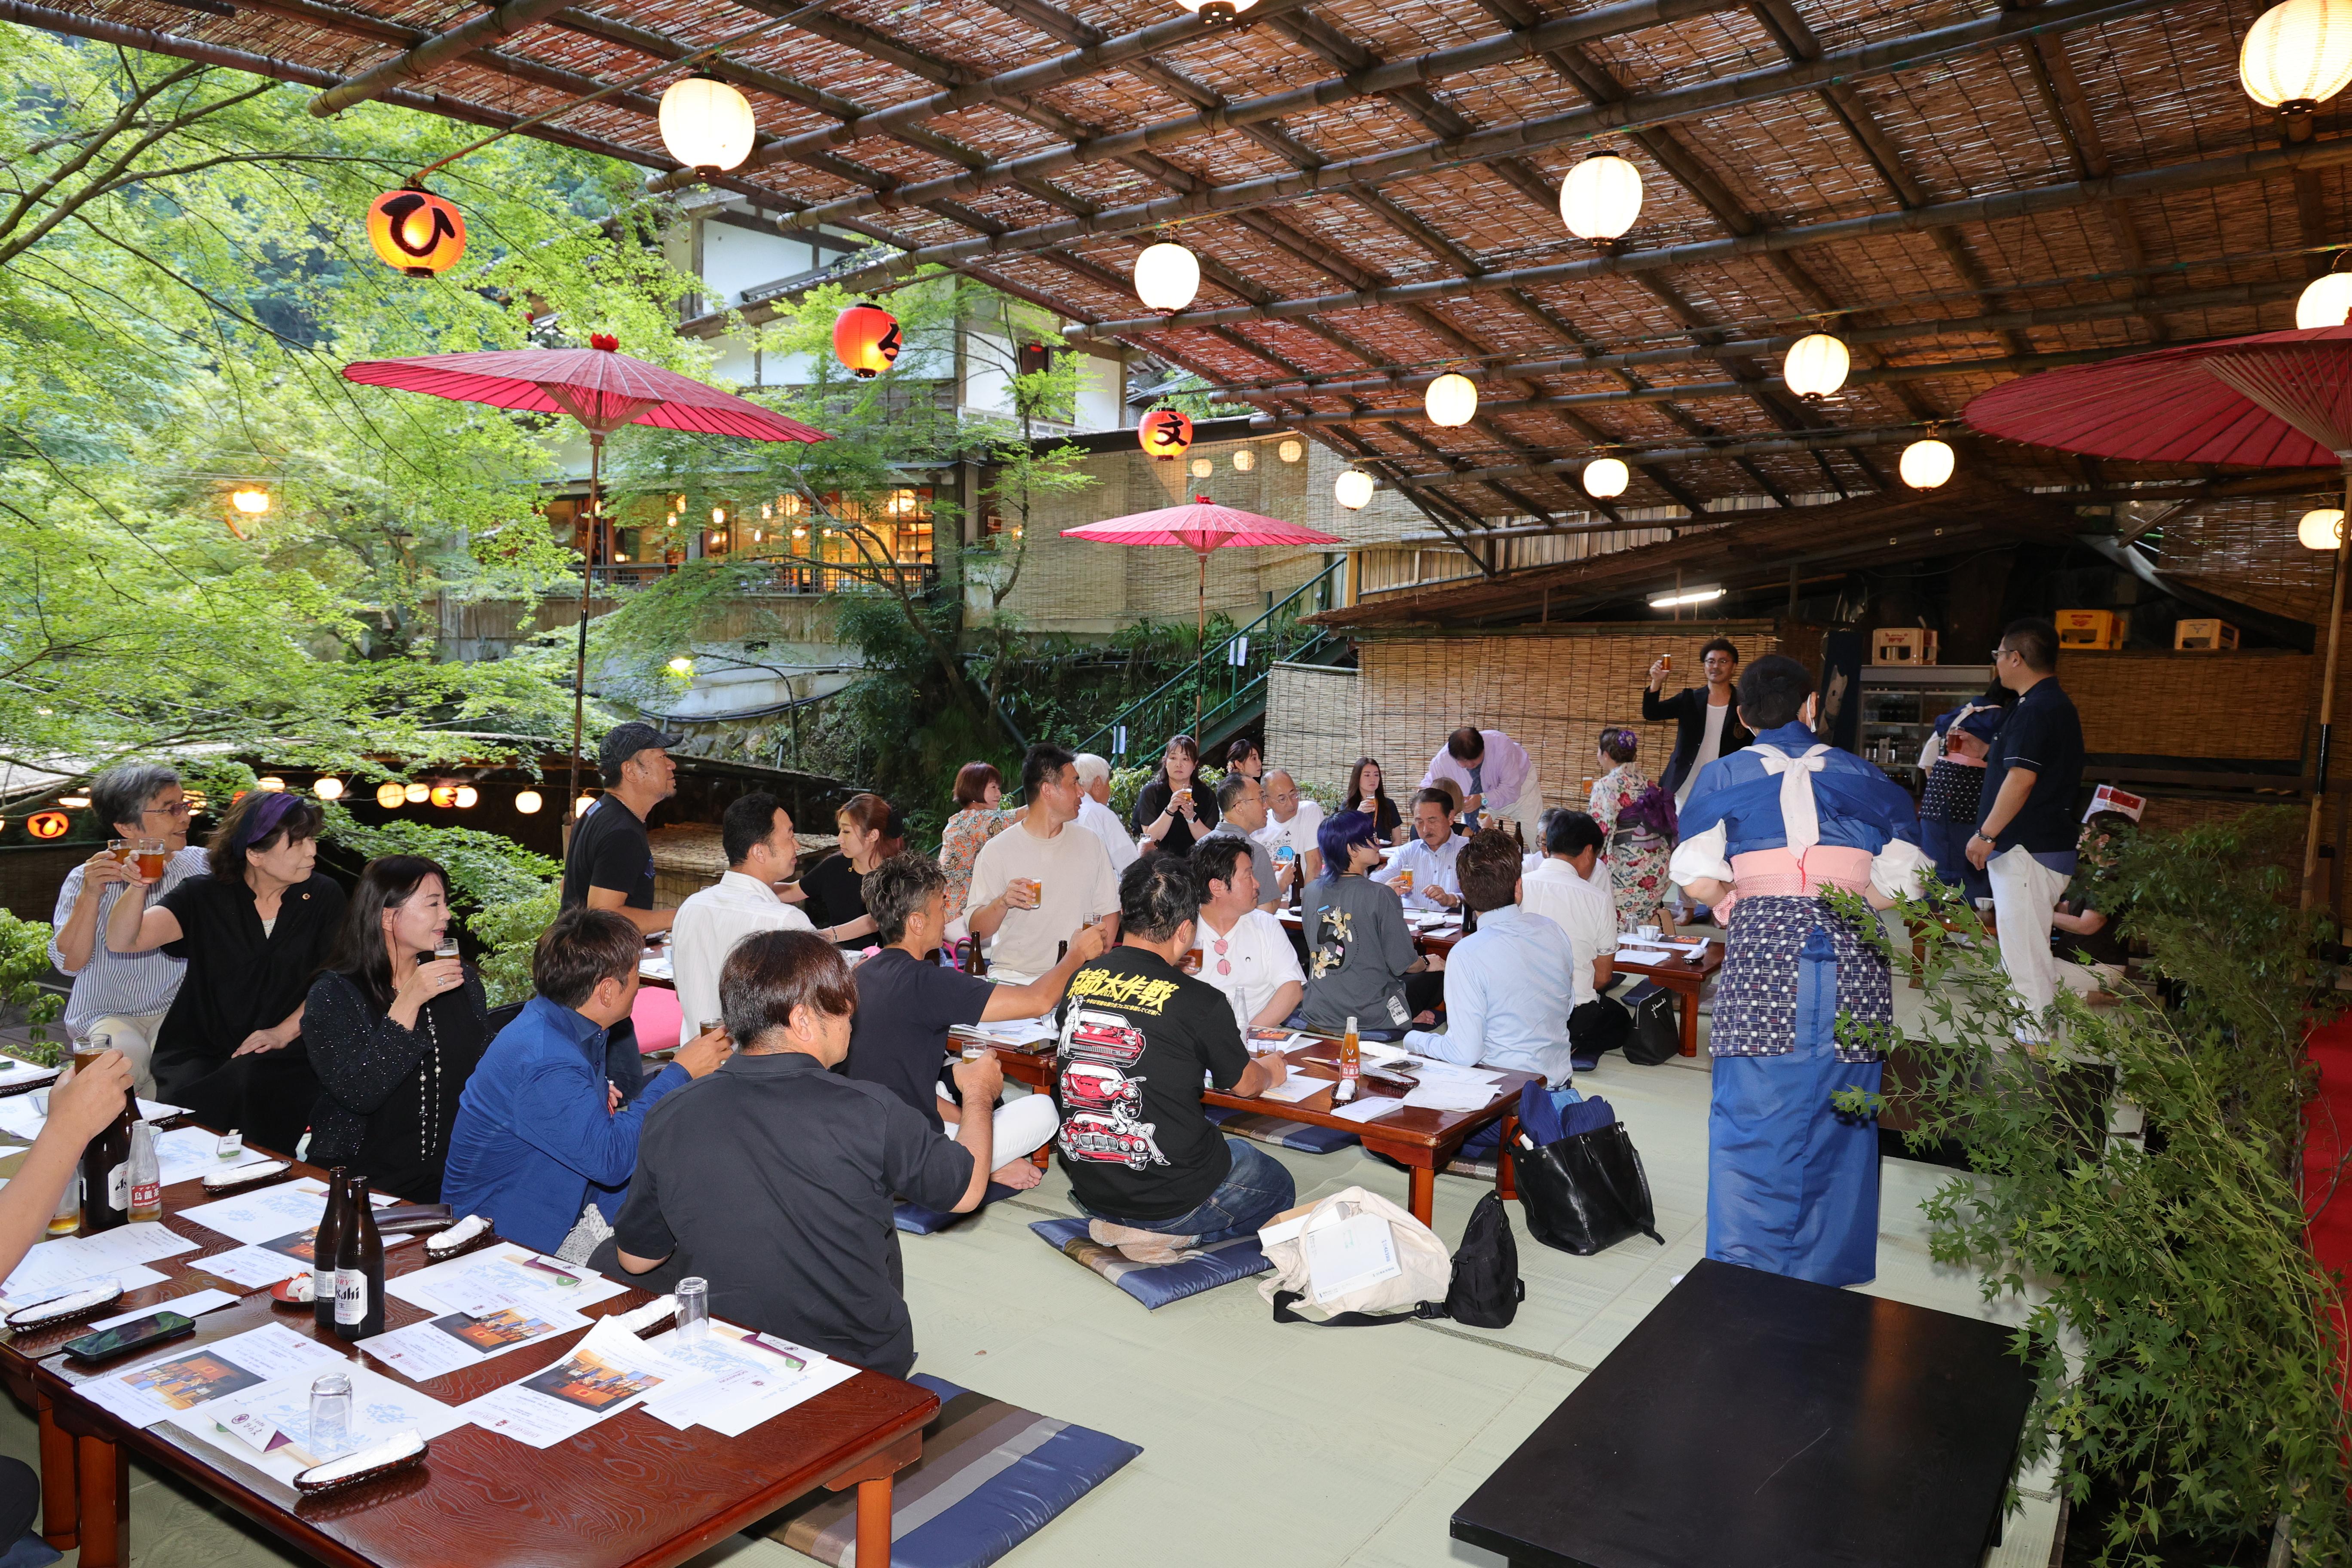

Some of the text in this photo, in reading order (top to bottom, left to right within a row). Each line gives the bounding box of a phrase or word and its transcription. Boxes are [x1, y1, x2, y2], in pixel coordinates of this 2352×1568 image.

[380, 194, 455, 257] ひ
[1153, 413, 1188, 446] 文
[35, 817, 64, 836] ひ
[335, 1285, 359, 1300] sahi
